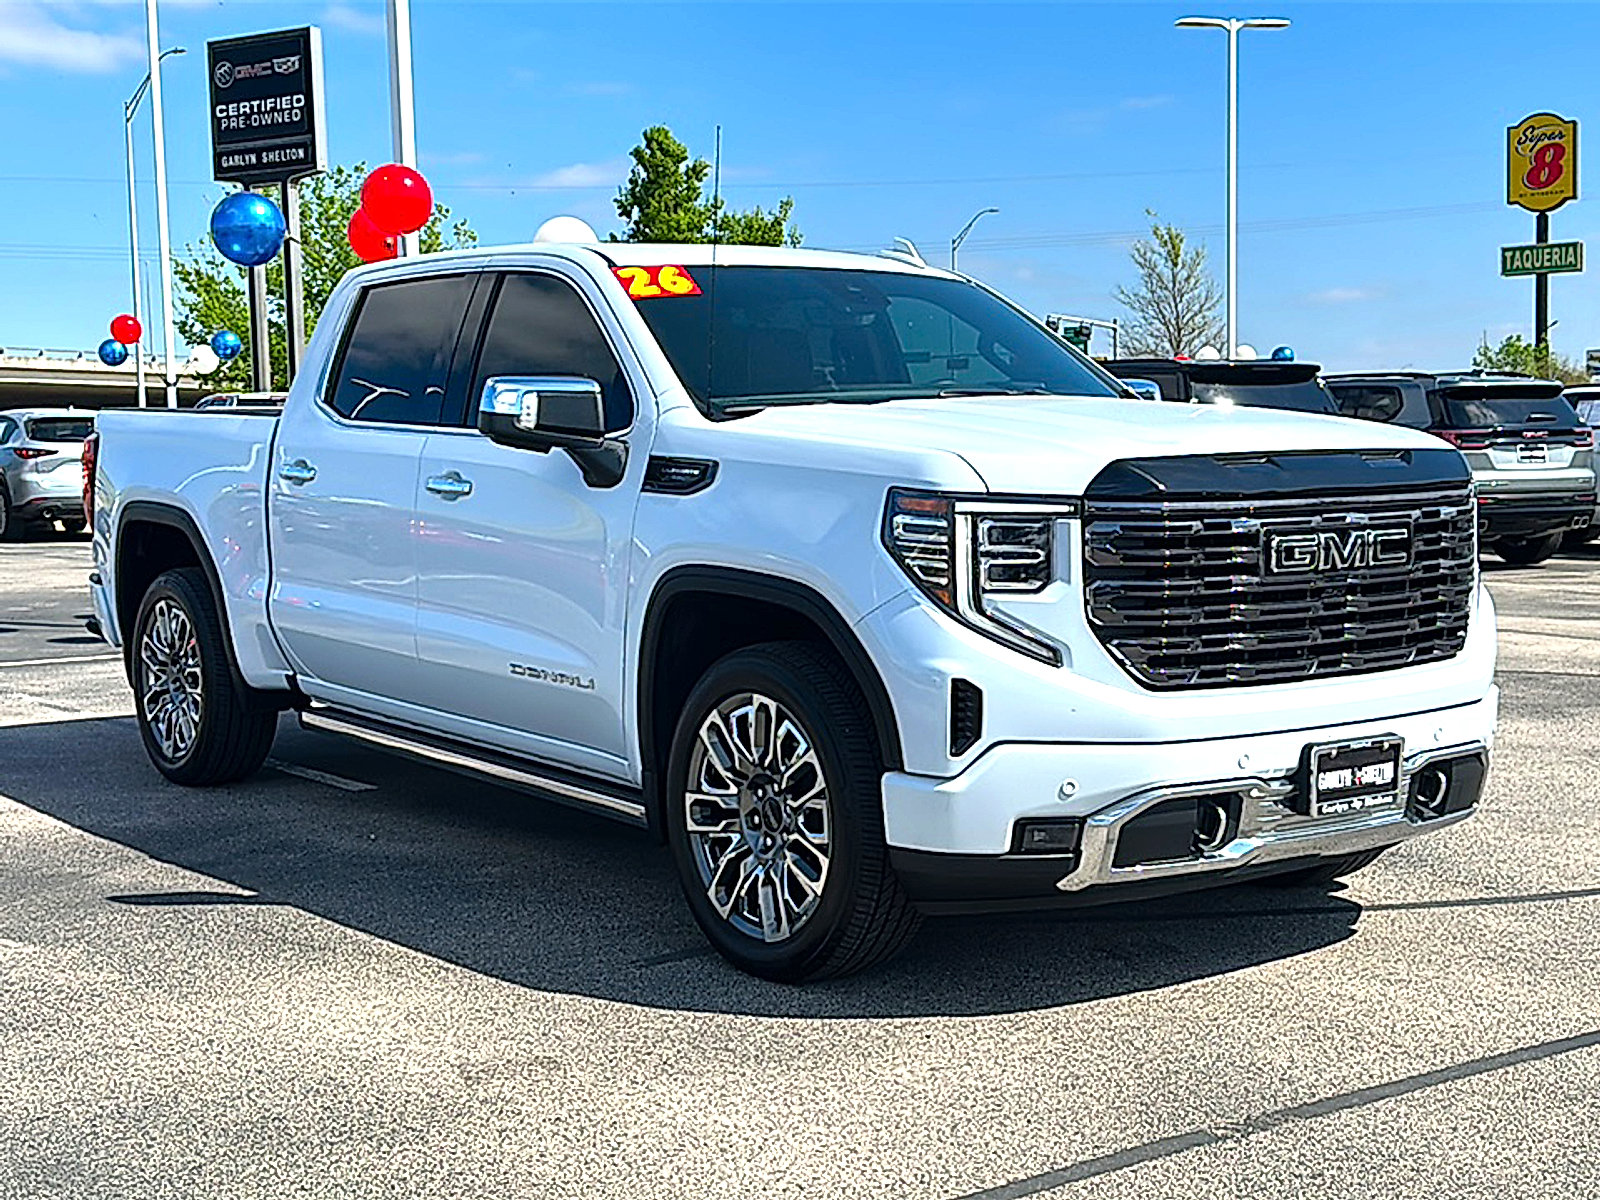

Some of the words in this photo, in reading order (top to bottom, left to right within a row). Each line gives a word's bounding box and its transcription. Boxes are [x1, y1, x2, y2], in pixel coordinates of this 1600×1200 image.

[215, 94, 305, 118] CERTIFIED
[221, 108, 301, 131] PRE-OWNED
[1515, 124, 1566, 153] Super
[221, 152, 257, 168] GARLYN
[261, 147, 305, 164] SHELTON
[1523, 142, 1567, 190] 8
[1504, 246, 1576, 270] TAQUERIA
[616, 266, 694, 296] 26
[1270, 528, 1408, 573] GMC
